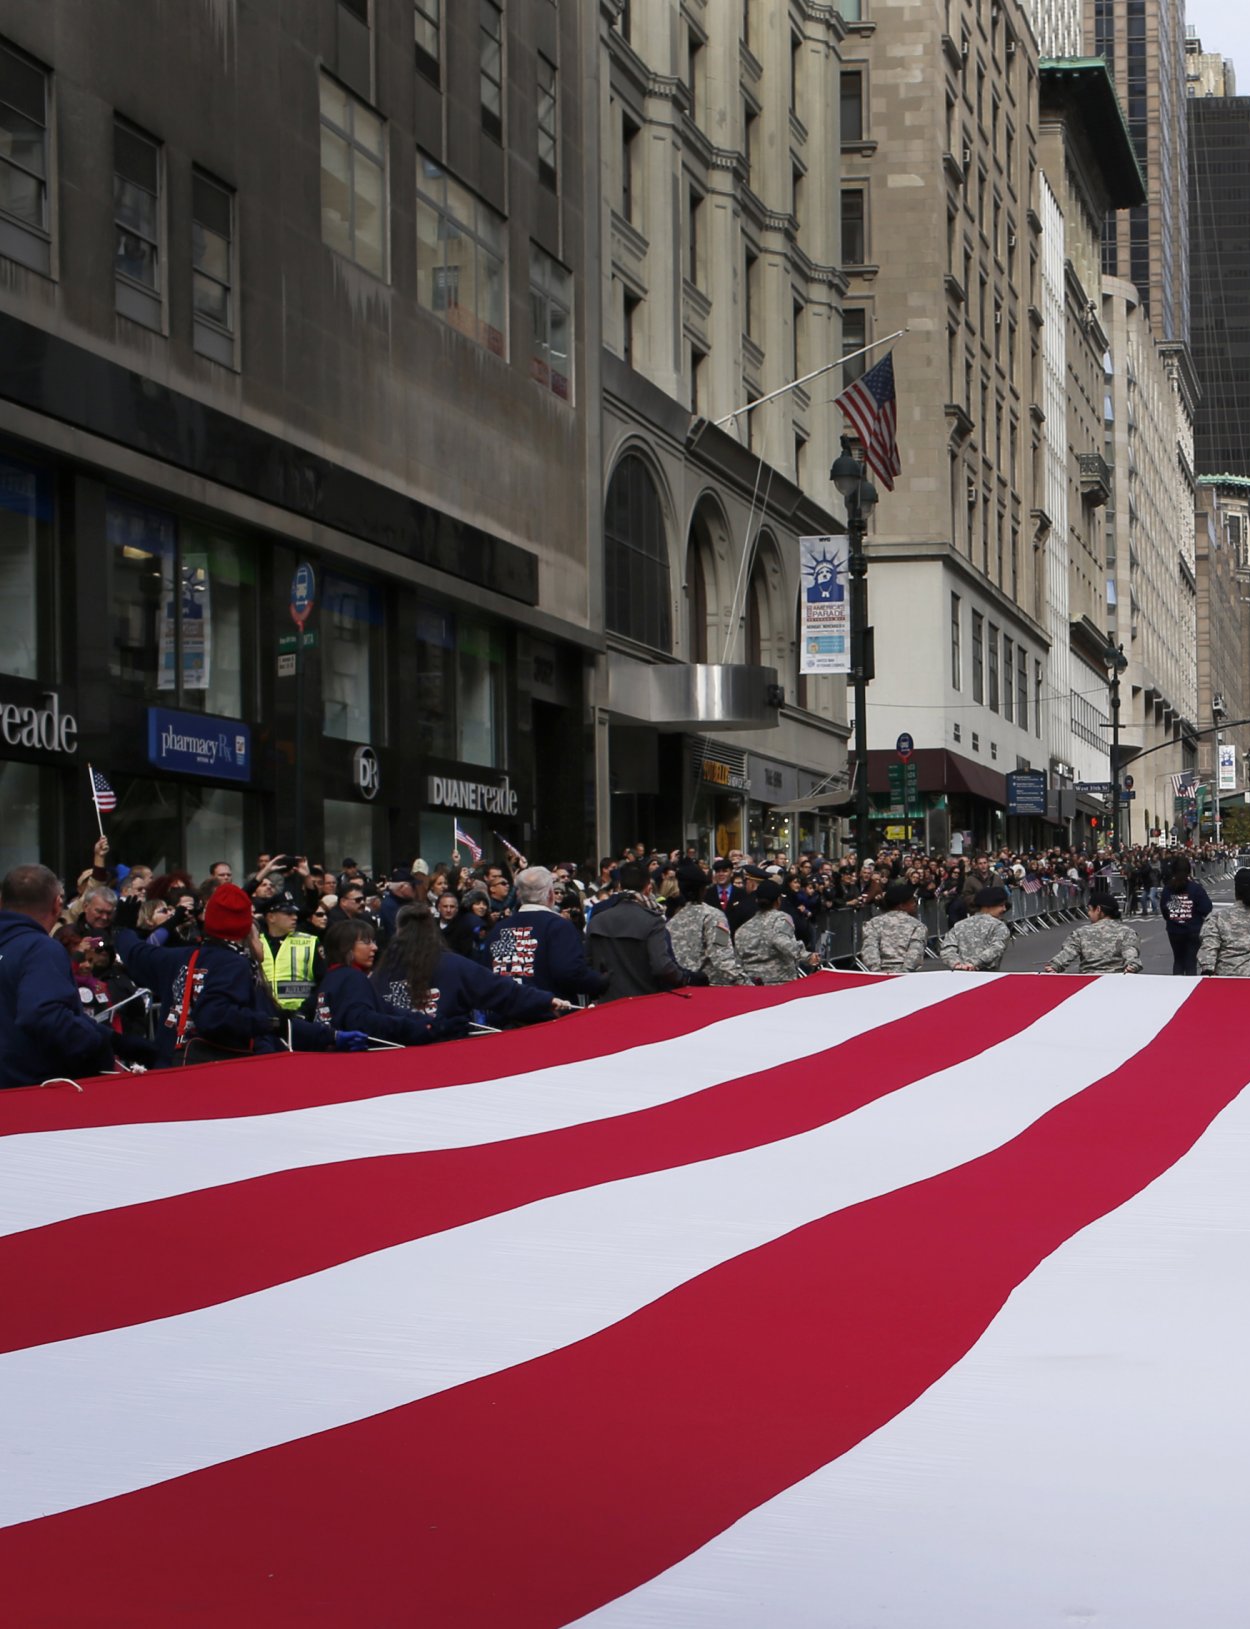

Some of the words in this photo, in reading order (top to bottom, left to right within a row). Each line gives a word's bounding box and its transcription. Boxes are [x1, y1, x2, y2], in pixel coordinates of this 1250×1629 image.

[0, 691, 78, 753] eade
[161, 724, 218, 764] pharmacy
[359, 758, 380, 788] DR
